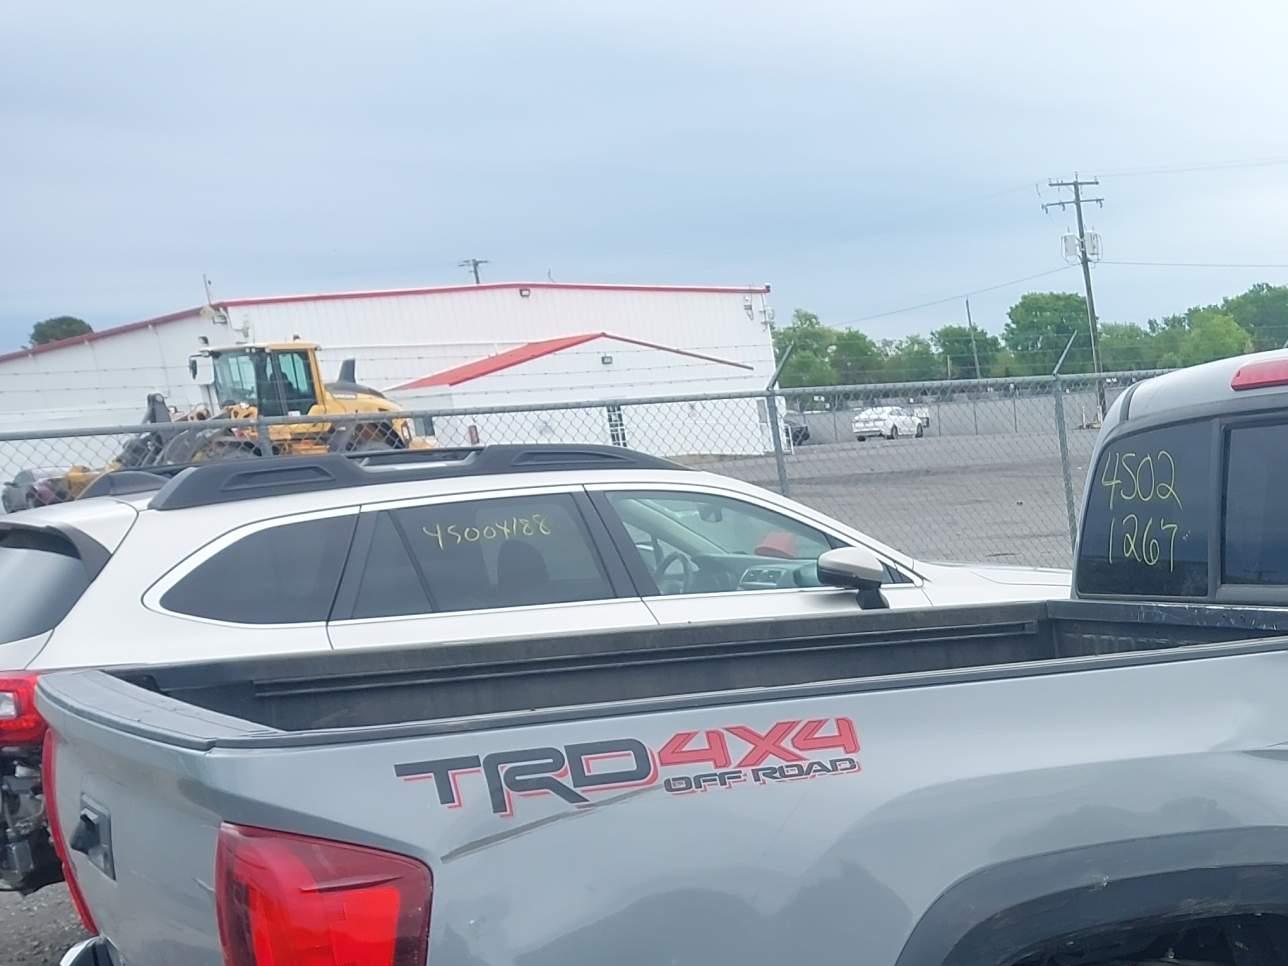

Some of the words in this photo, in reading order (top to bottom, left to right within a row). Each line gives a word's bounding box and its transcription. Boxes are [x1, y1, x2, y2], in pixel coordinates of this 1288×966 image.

[1101, 450, 1184, 511] 4502
[422, 513, 552, 551] 45004188
[1107, 513, 1180, 574] 1267
[394, 736, 659, 817] TRD
[656, 716, 861, 771] 4X4
[663, 768, 750, 796] OFF
[751, 756, 862, 785] ROAD
